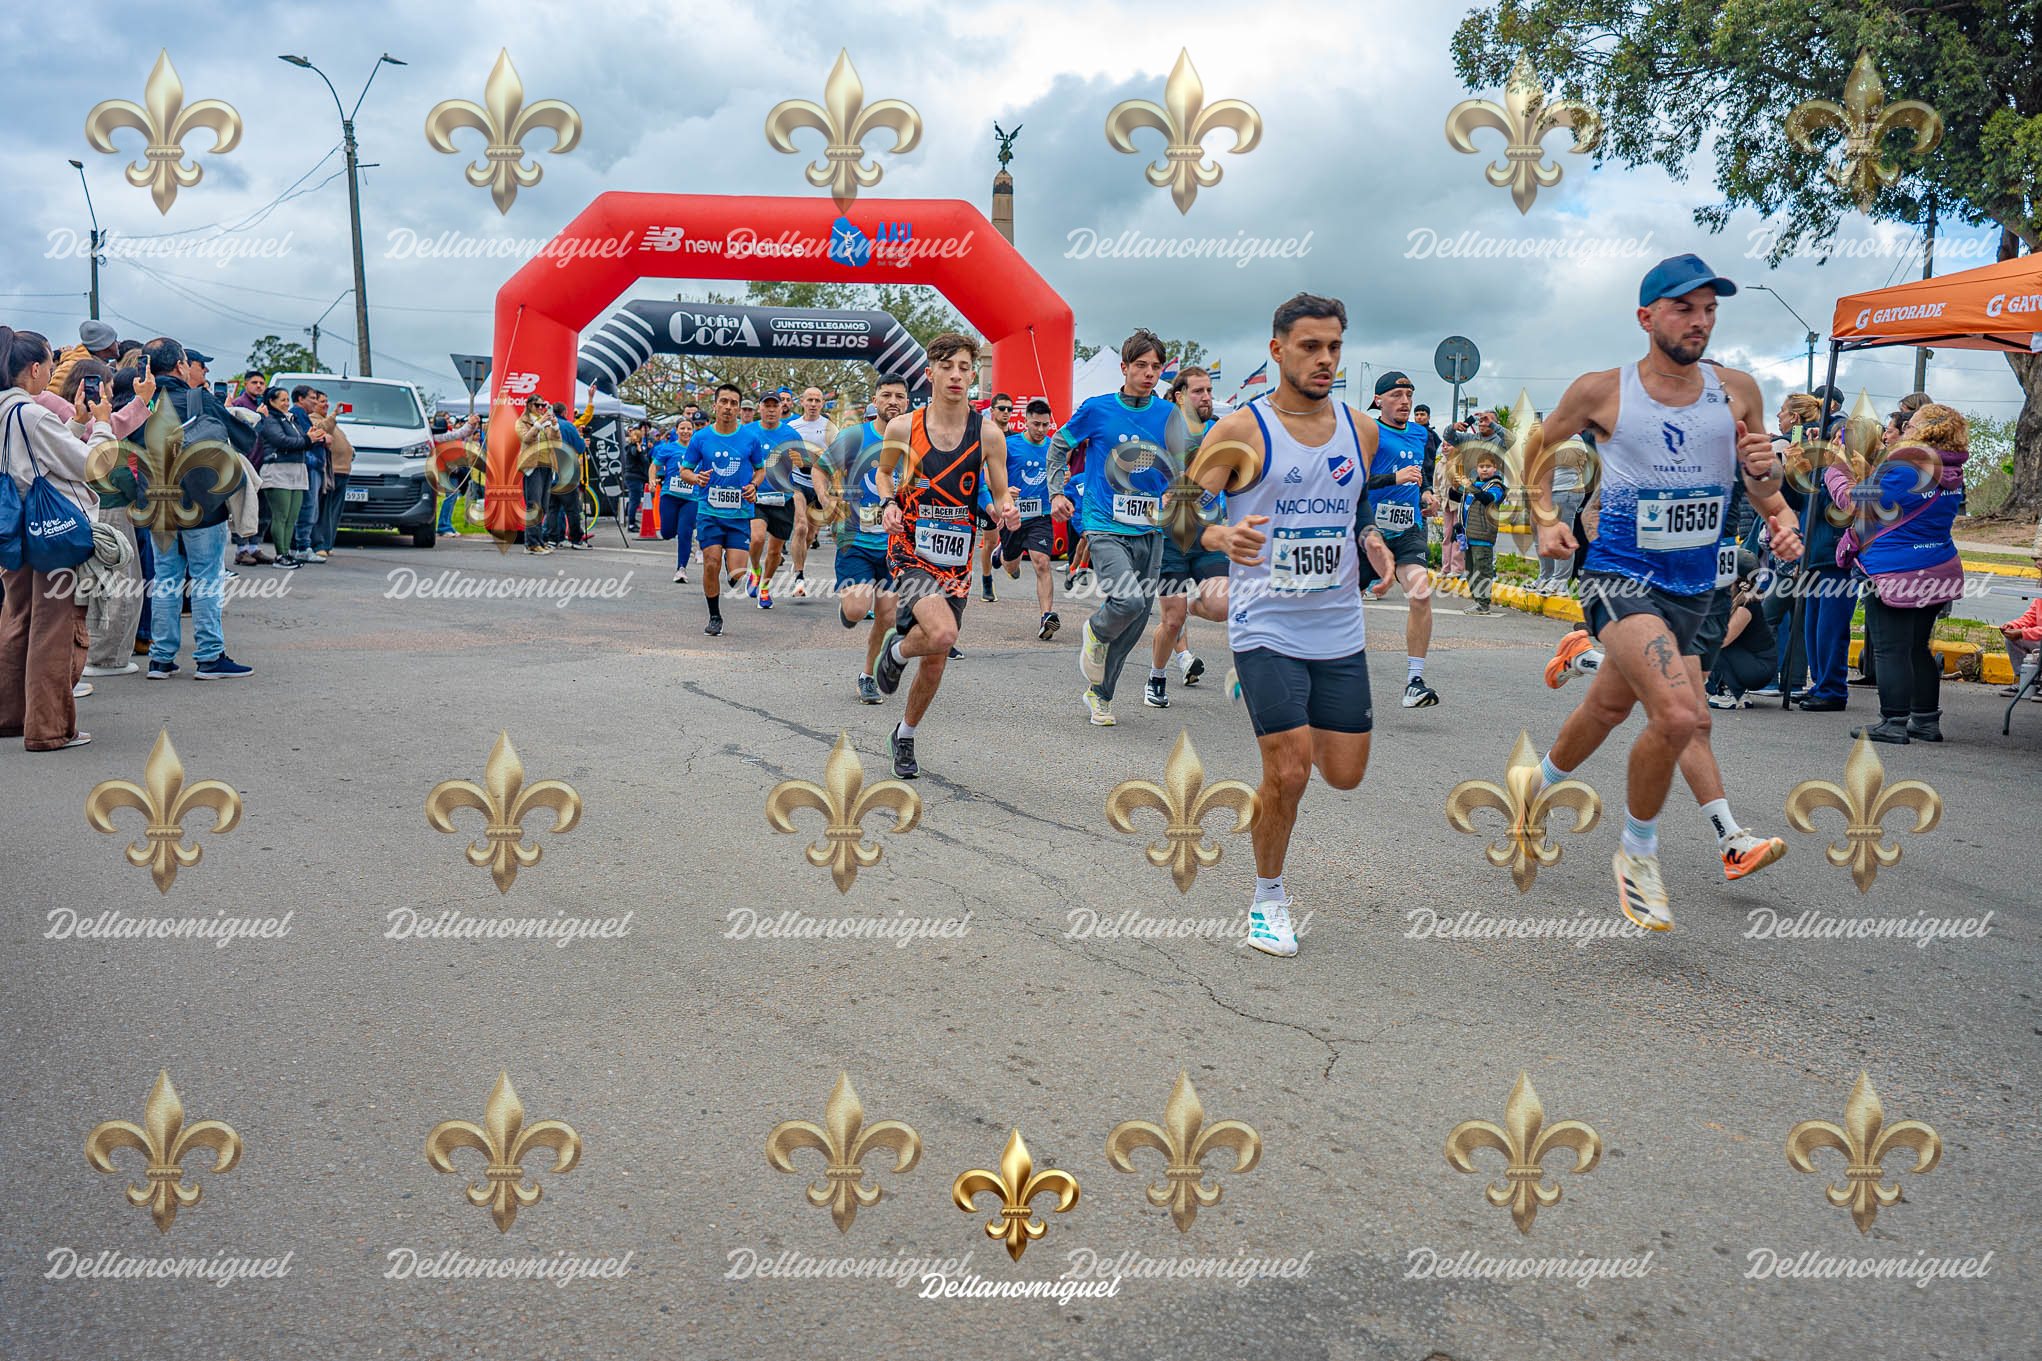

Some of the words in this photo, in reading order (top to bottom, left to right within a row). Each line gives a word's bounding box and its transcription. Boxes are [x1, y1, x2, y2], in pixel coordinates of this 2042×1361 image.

[685, 239, 723, 254] new
[695, 313, 739, 329] Doña
[1872, 302, 1948, 324] GATORADE
[776, 320, 815, 330] JUNTOS
[815, 321, 866, 332] LLEGAMOS
[772, 330, 813, 347] MÁS
[816, 333, 869, 349] LEJOS
[717, 491, 740, 503] 15668
[934, 507, 953, 516] ACER
[1019, 501, 1038, 513] 15677
[1274, 498, 1350, 515] NACIONAL
[1389, 508, 1414, 526] 16594
[1666, 501, 1719, 533] 16538
[931, 533, 965, 557] 15748
